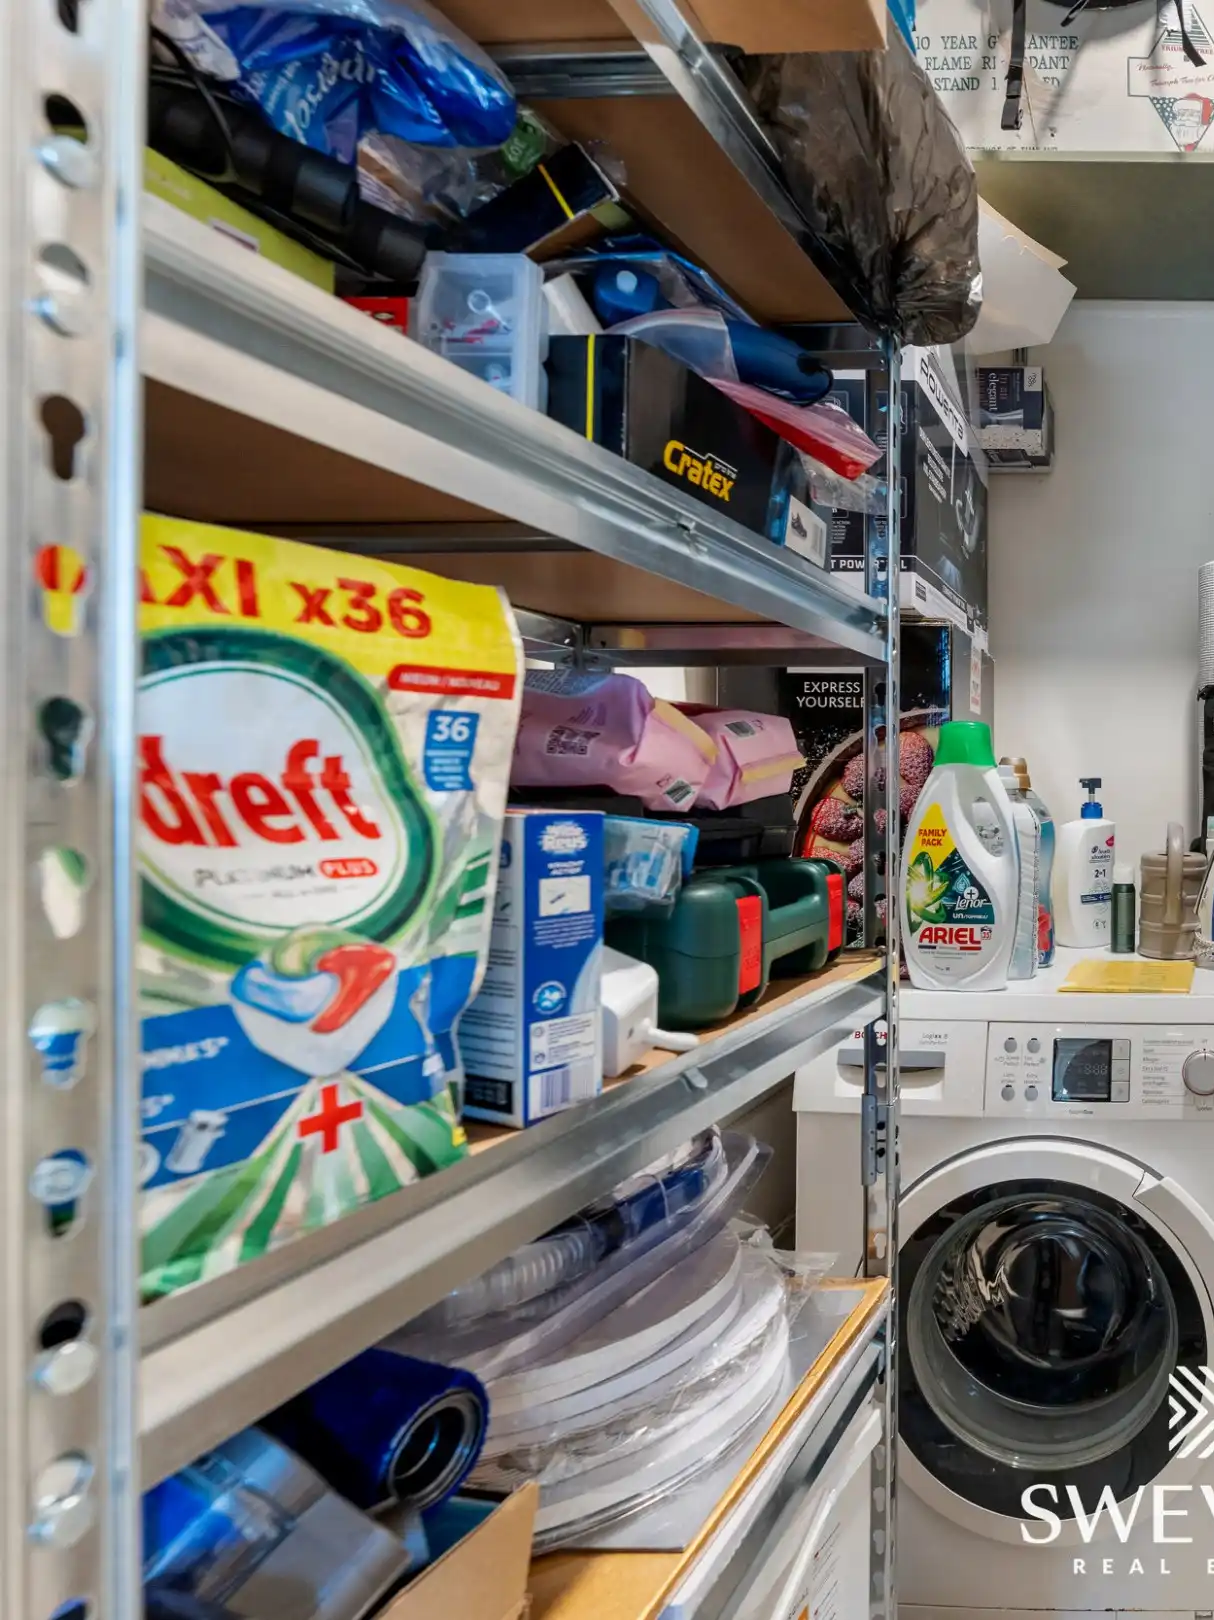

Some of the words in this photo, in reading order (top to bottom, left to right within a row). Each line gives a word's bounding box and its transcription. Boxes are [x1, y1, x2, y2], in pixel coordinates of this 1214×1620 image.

[916, 36, 931, 50] 10
[941, 35, 978, 50] YEAR
[925, 56, 972, 71] FLAME
[934, 77, 980, 91] STAND
[987, 372, 999, 412] elegant
[663, 439, 735, 502] Cratex
[288, 576, 433, 639] x36
[803, 682, 861, 694] EXPRESS
[431, 715, 472, 742] 36
[138, 735, 382, 848] dreft
[918, 828, 947, 838] FAMILY
[921, 838, 943, 847] PACK
[955, 895, 987, 912] Lenor
[918, 927, 982, 945] ARIEL
